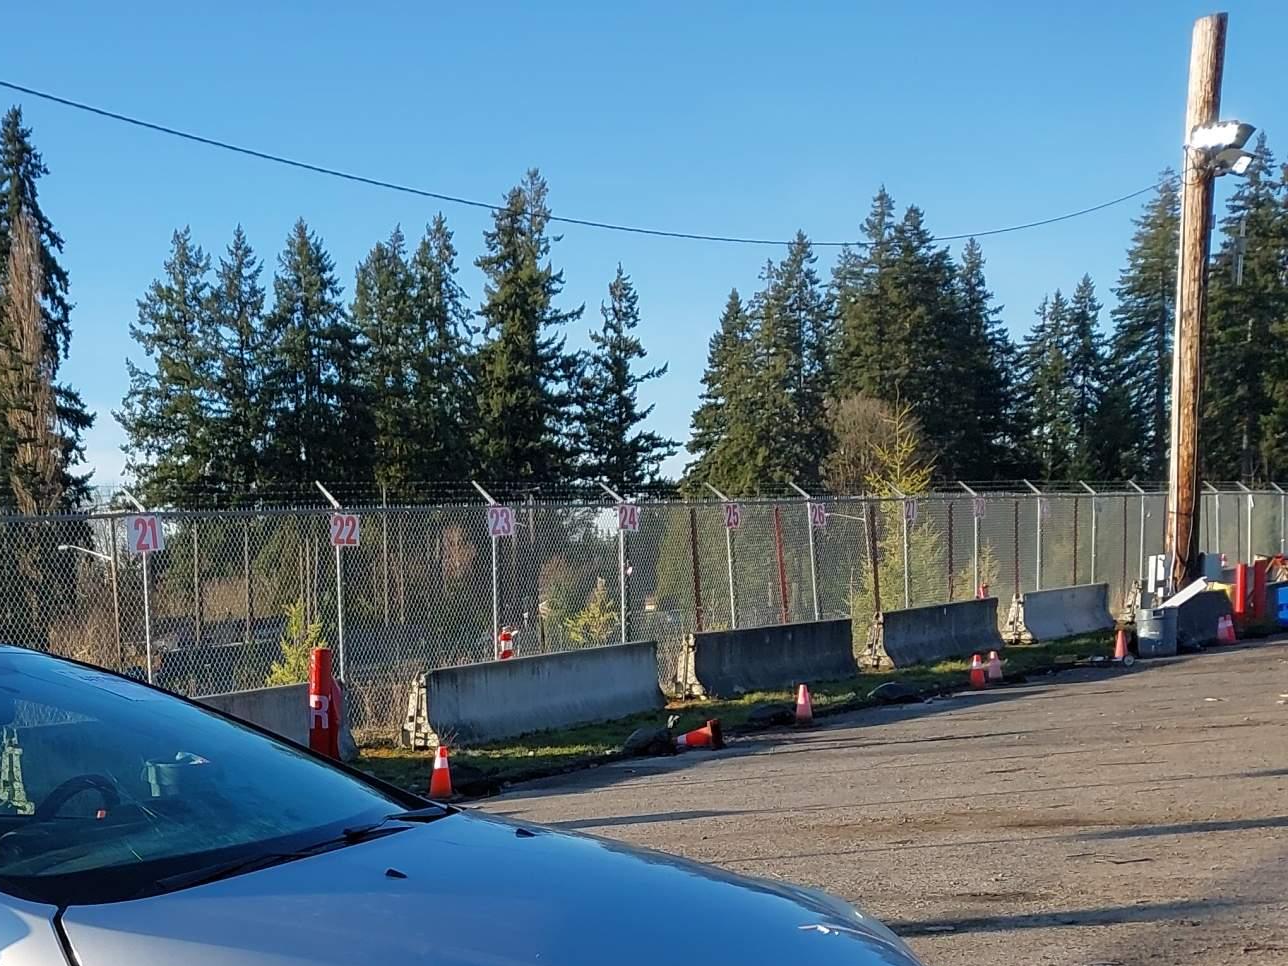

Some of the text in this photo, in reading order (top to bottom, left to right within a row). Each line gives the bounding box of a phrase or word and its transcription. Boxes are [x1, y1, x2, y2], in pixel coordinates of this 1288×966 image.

[490, 509, 511, 535] 23
[620, 506, 637, 530] 24
[726, 504, 739, 527] 25
[811, 505, 825, 525] 26
[134, 517, 159, 550] 21
[333, 515, 357, 545] 22
[309, 694, 329, 729] R
